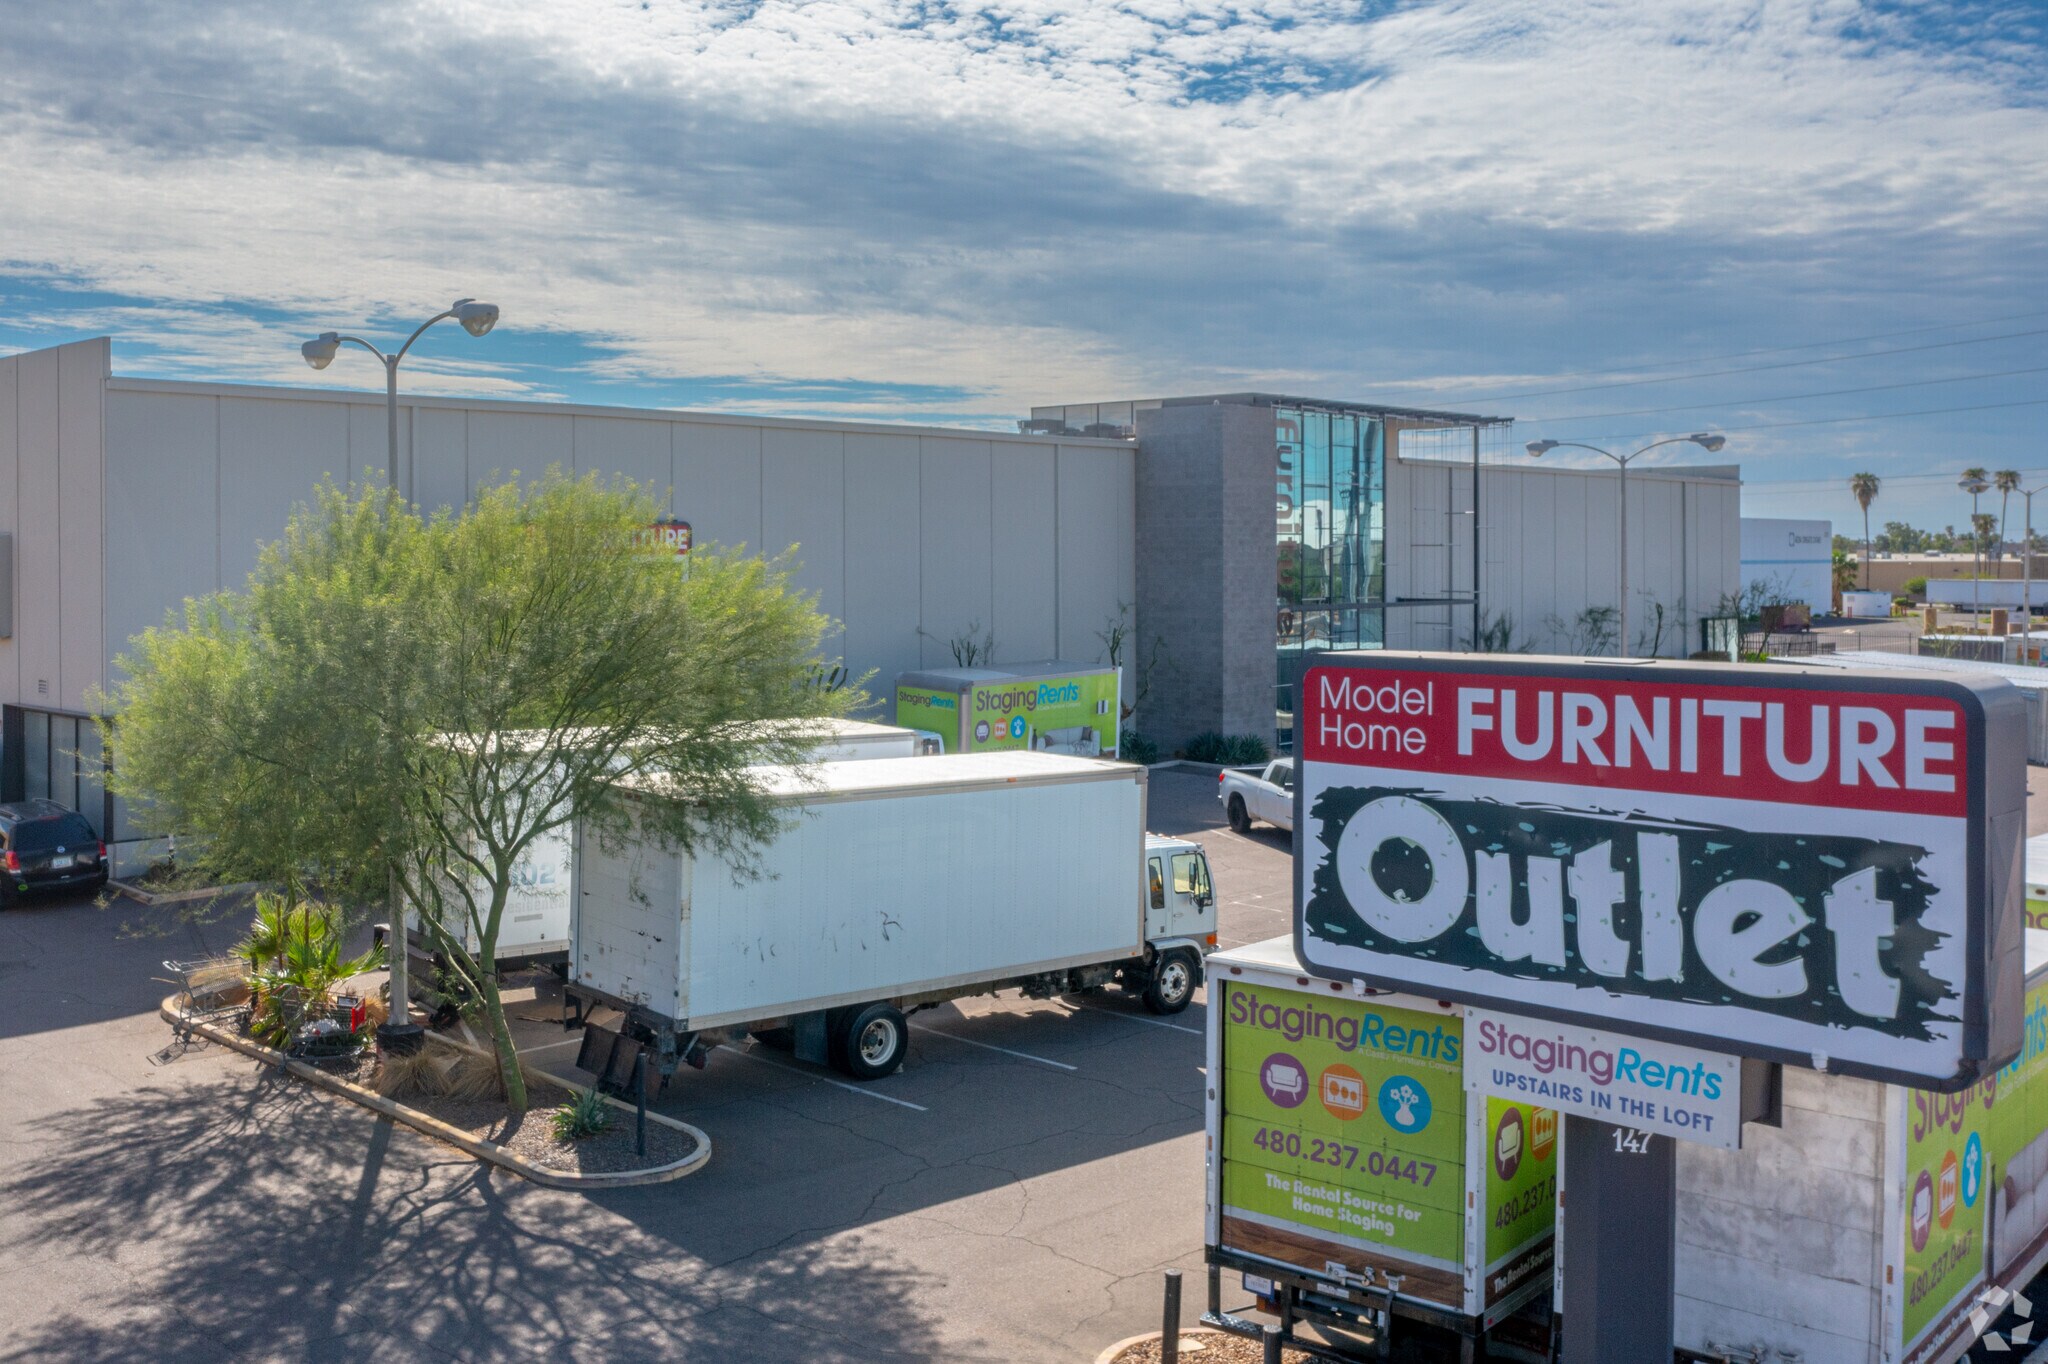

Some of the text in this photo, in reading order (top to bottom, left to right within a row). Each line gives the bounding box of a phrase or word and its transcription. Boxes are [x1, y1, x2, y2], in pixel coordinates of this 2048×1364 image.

[1277, 417, 1300, 638] Furnitue
[975, 680, 1080, 714] StagingRents
[1319, 674, 1433, 716] Model
[1319, 706, 1427, 755] Home
[1457, 687, 1957, 793] FURNITURE
[1336, 796, 1901, 1019] Outlet
[1230, 991, 1460, 1062] StagingRents
[1479, 1020, 1722, 1100] StagingRents
[1493, 1069, 1714, 1132] UPSTAIRS IN THE LOFT
[1253, 1127, 1437, 1188] 480.237.0447
[1612, 1128, 1653, 1154] 147
[1265, 1173, 1290, 1191] The
[1293, 1179, 1340, 1203] Rental
[1343, 1191, 1394, 1215] Source
[1292, 1196, 1395, 1237] Home Staging
